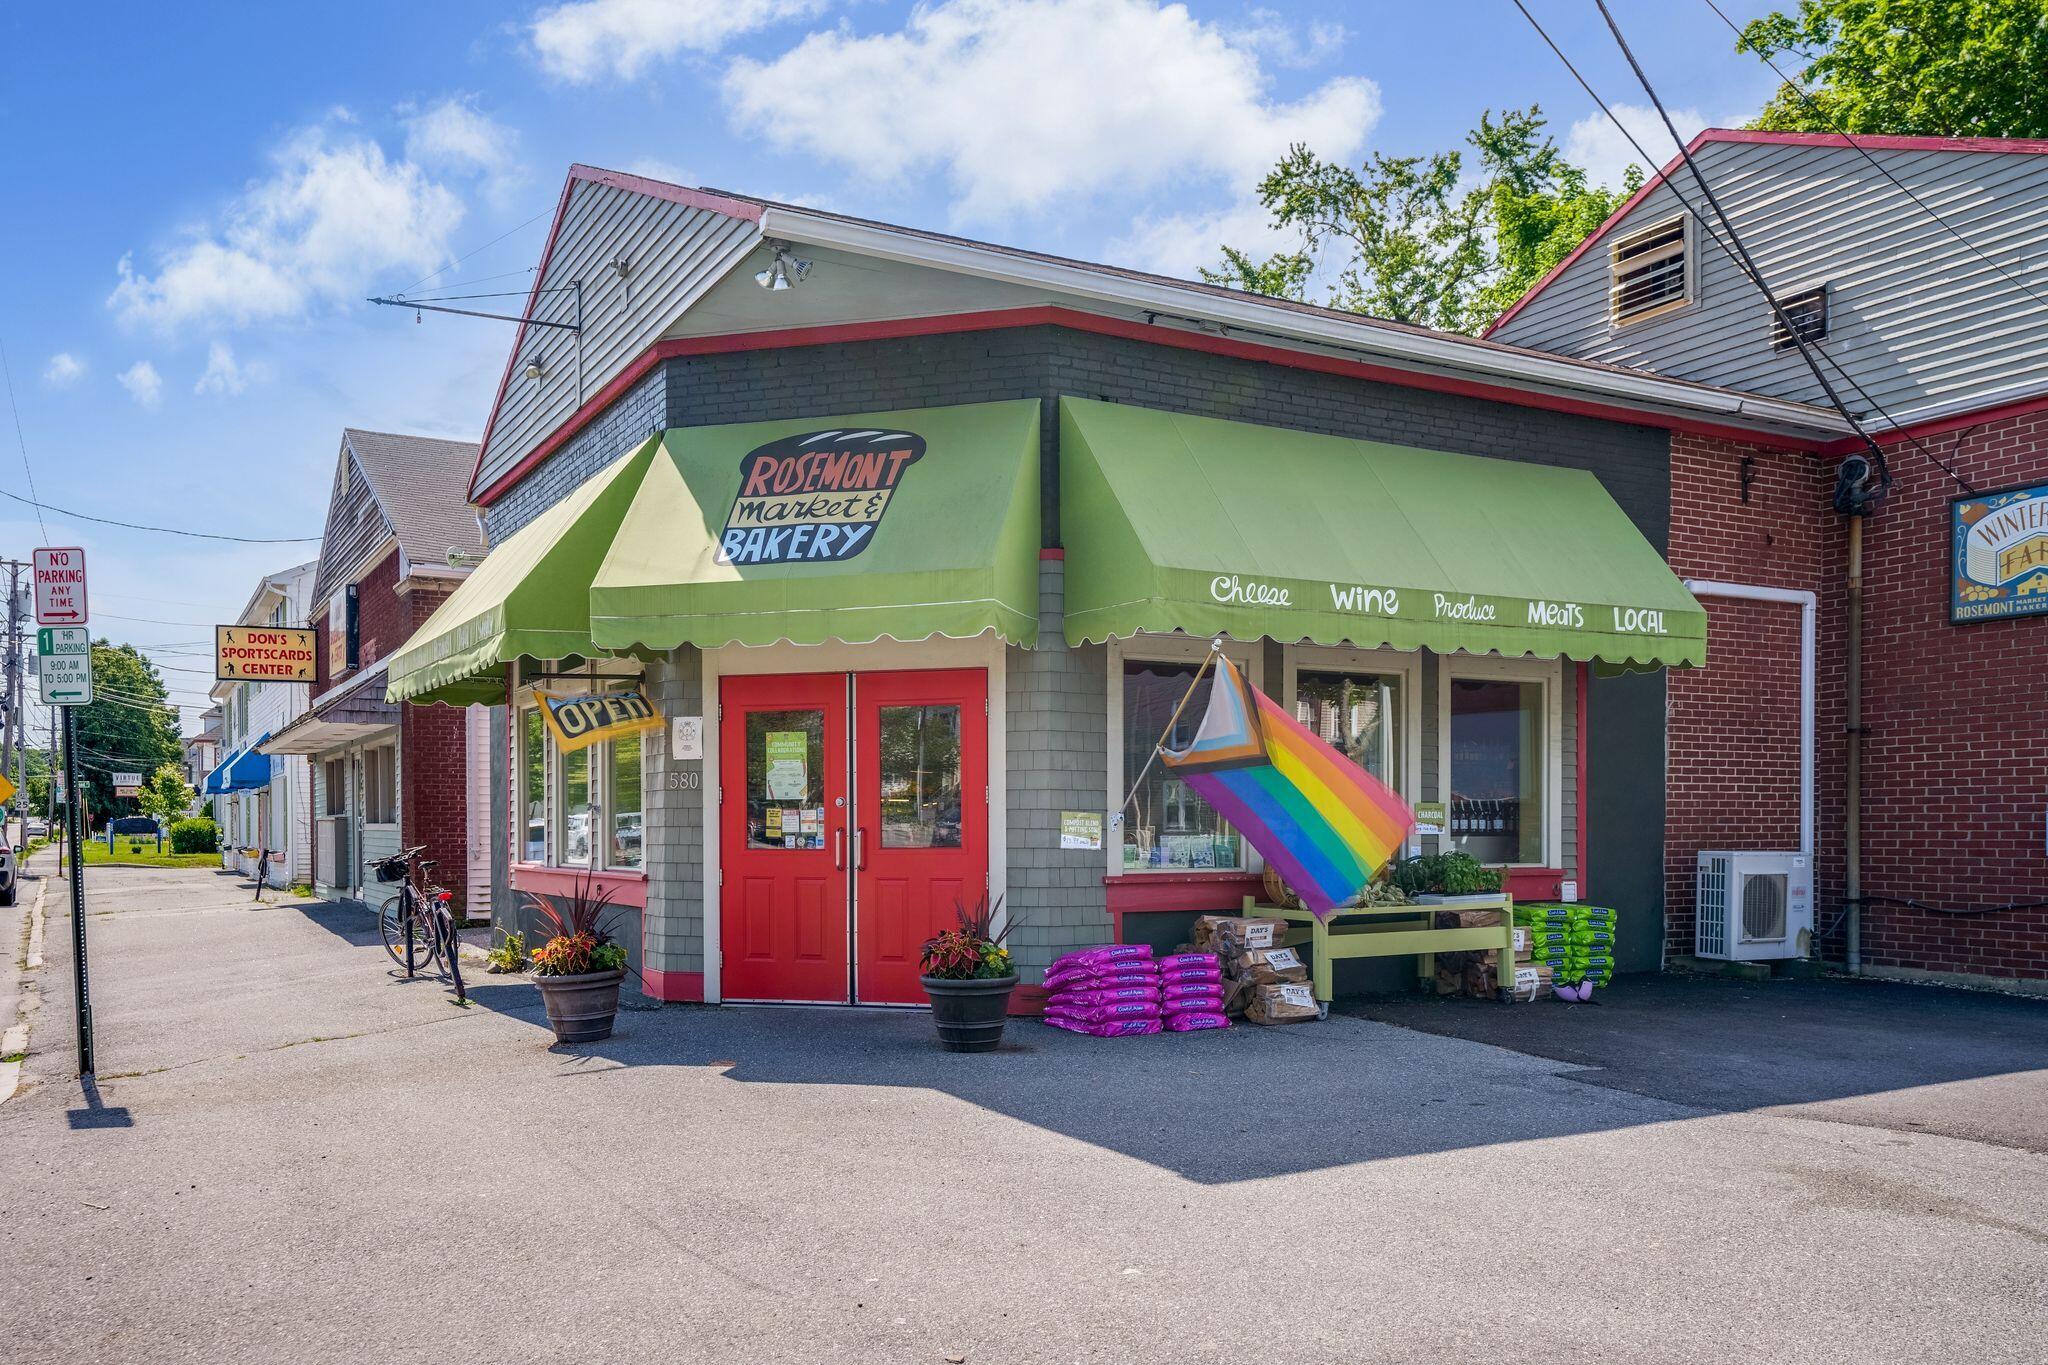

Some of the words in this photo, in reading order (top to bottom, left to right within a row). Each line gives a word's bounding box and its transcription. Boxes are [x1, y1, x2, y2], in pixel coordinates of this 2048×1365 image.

[743, 449, 913, 497] ROSEMONT
[736, 494, 862, 524] market
[864, 491, 883, 520] &
[716, 523, 873, 563] BAKERY
[50, 552, 69, 566] NO
[38, 569, 82, 583] PARKING
[51, 585, 71, 595] ANY
[49, 597, 74, 607] TIME
[1210, 575, 1293, 606] Cheese
[1329, 583, 1399, 615] Wine
[1433, 593, 1496, 621] Produce
[1613, 607, 1668, 634] LOCAL
[2016, 596, 2047, 606] MARKET
[1956, 600, 2014, 619] ROSEMONT
[43, 632, 49, 651] 1
[61, 630, 74, 640] HR
[247, 633, 287, 645] DON'S
[55, 642, 86, 653] PARKING
[221, 647, 313, 661] SPORTSCARDS
[50, 660, 66, 670] 9:00
[69, 660, 80, 670] AM
[242, 663, 293, 675] CENTER
[44, 673, 54, 684] TO
[57, 673, 74, 683] 5:00
[76, 673, 87, 683] PM
[558, 698, 651, 734] OPEN
[670, 772, 699, 789] 580
[16, 801, 28, 809] 25
